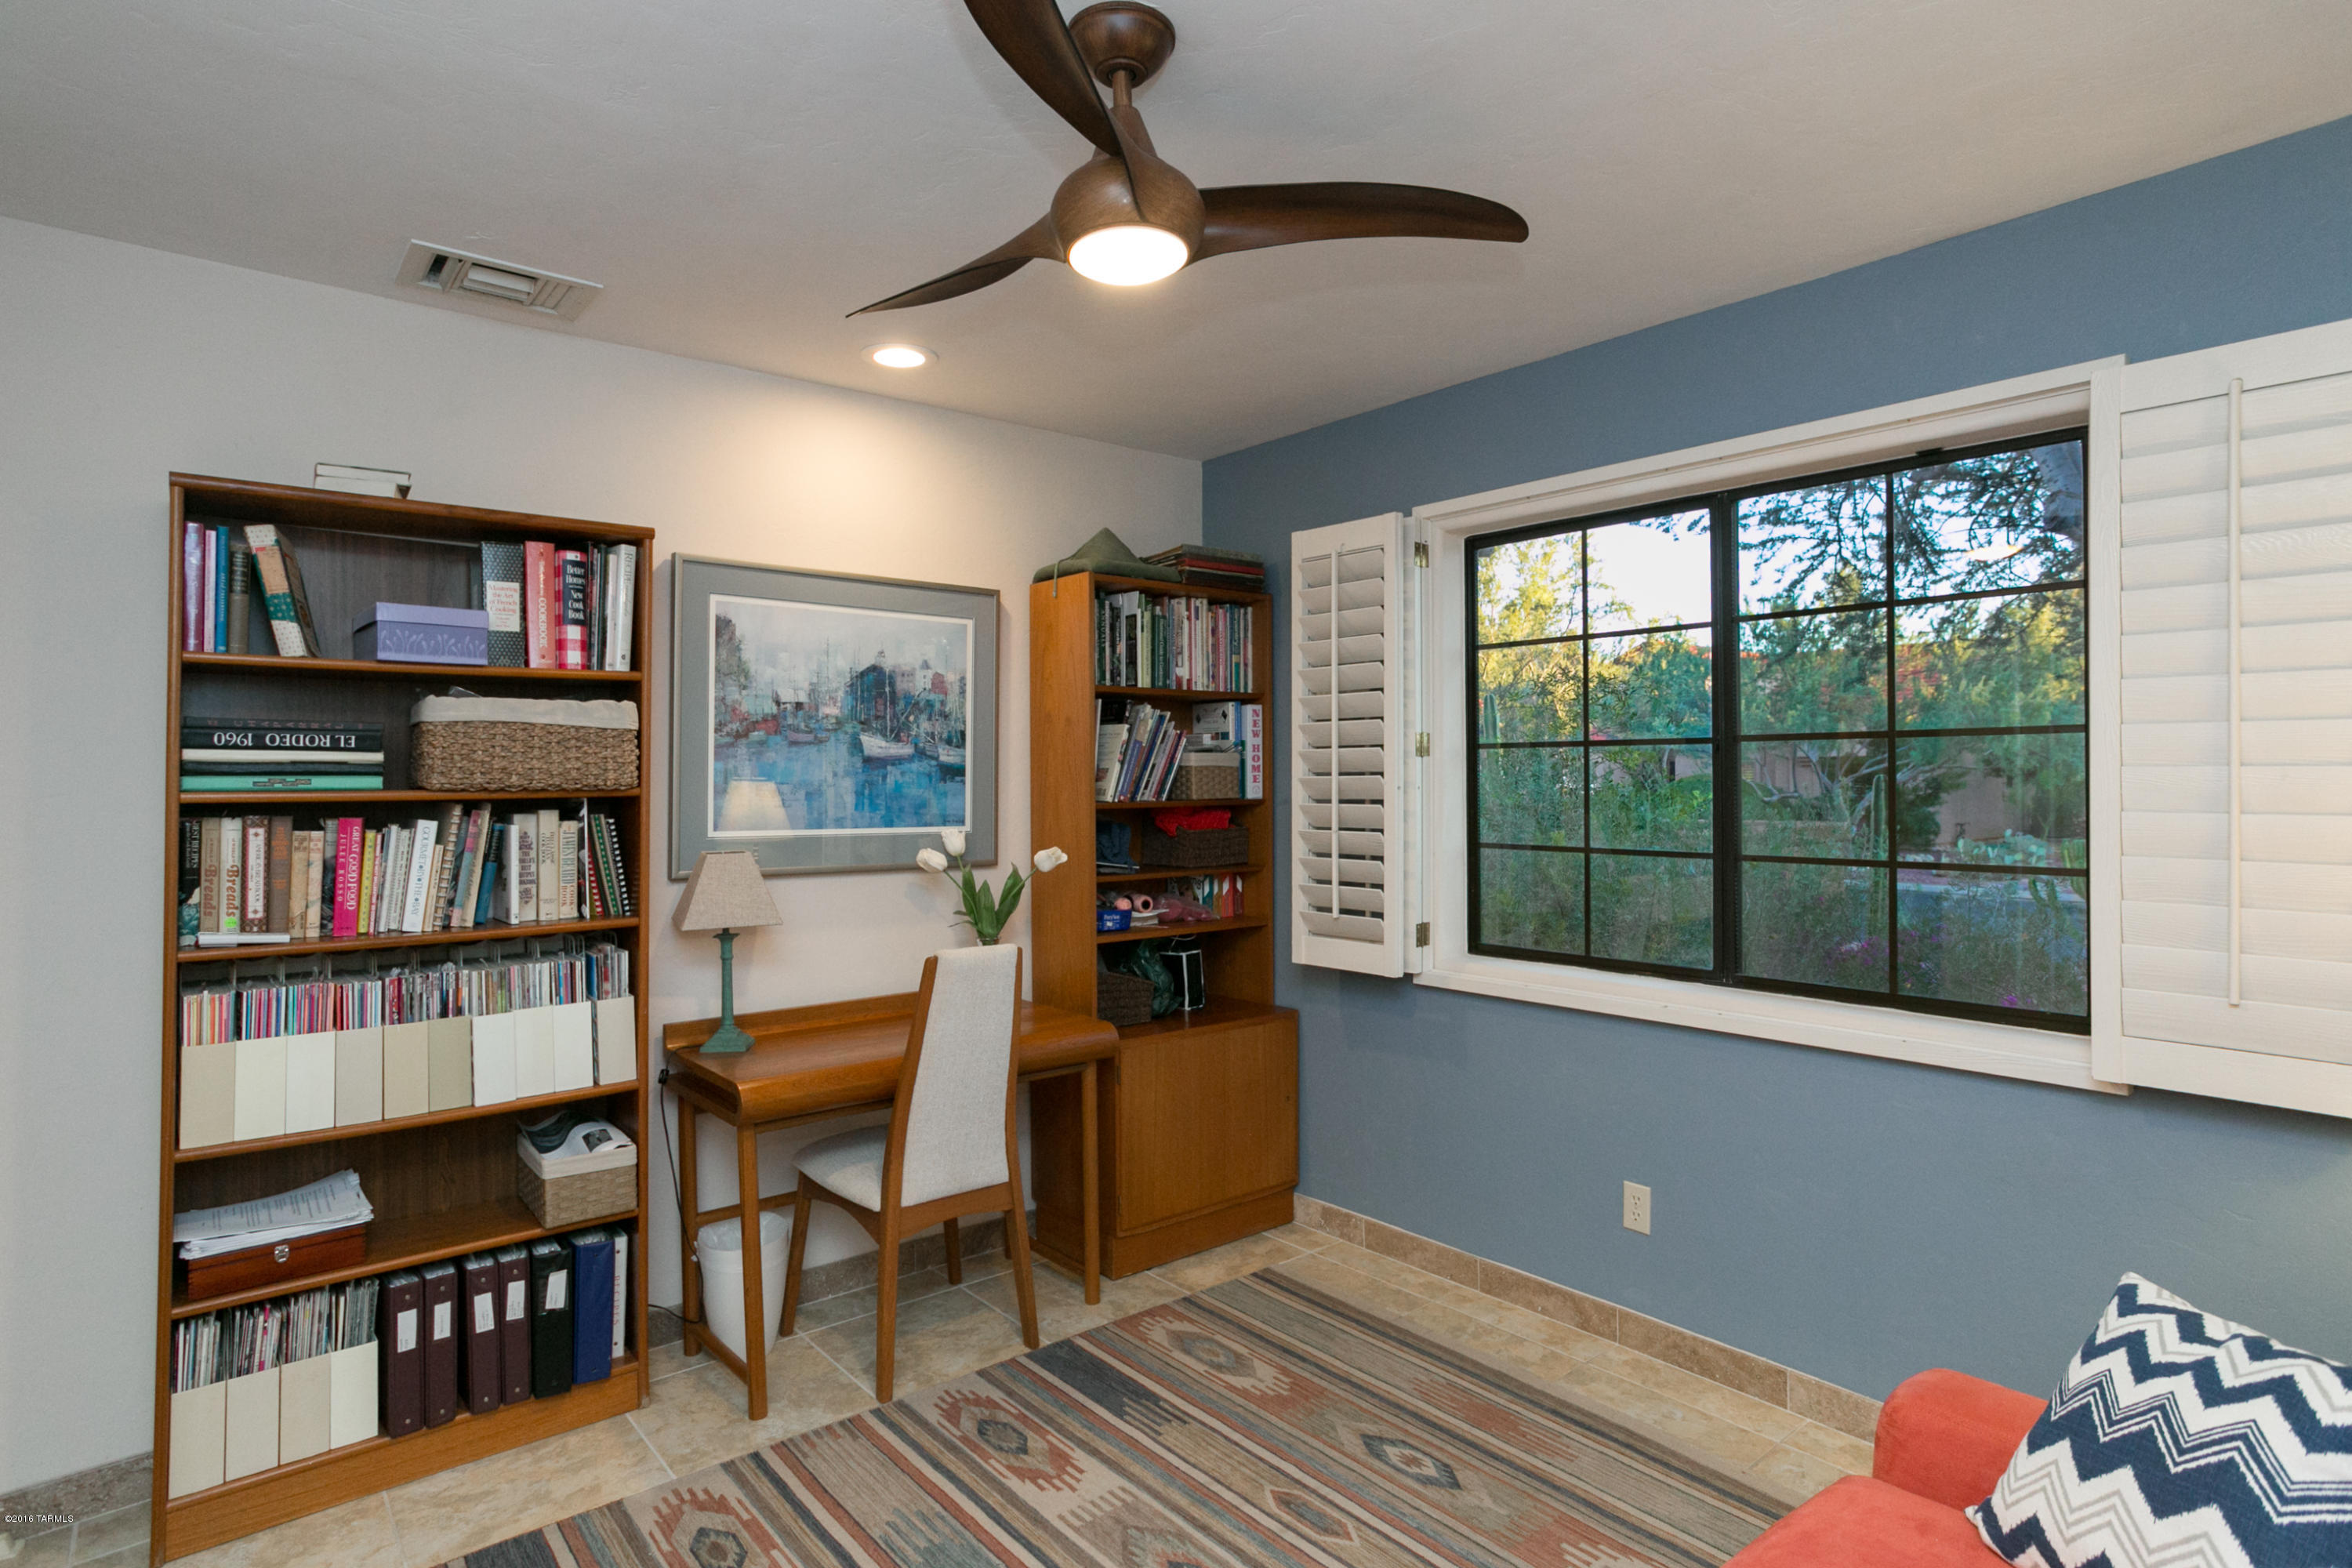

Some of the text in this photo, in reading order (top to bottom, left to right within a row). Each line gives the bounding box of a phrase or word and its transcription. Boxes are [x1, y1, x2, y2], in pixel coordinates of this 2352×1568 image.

[566, 575, 586, 584] Homes
[567, 564, 585, 575] Better
[568, 600, 584, 609] Cook
[571, 590, 583, 599] New
[539, 597, 547, 648] COOKBOOK
[568, 609, 585, 619] Book
[213, 732, 356, 748] EL RODEO 1960
[1251, 709, 1261, 783] NEW HOME
[562, 830, 575, 857] JAMES
[347, 826, 360, 909] GREAT GOOD FOOD
[411, 826, 431, 916] GOURMET BY THE BAY
[561, 858, 575, 884] BEARD
[203, 864, 217, 916] Breads
[226, 865, 239, 917] Breads
